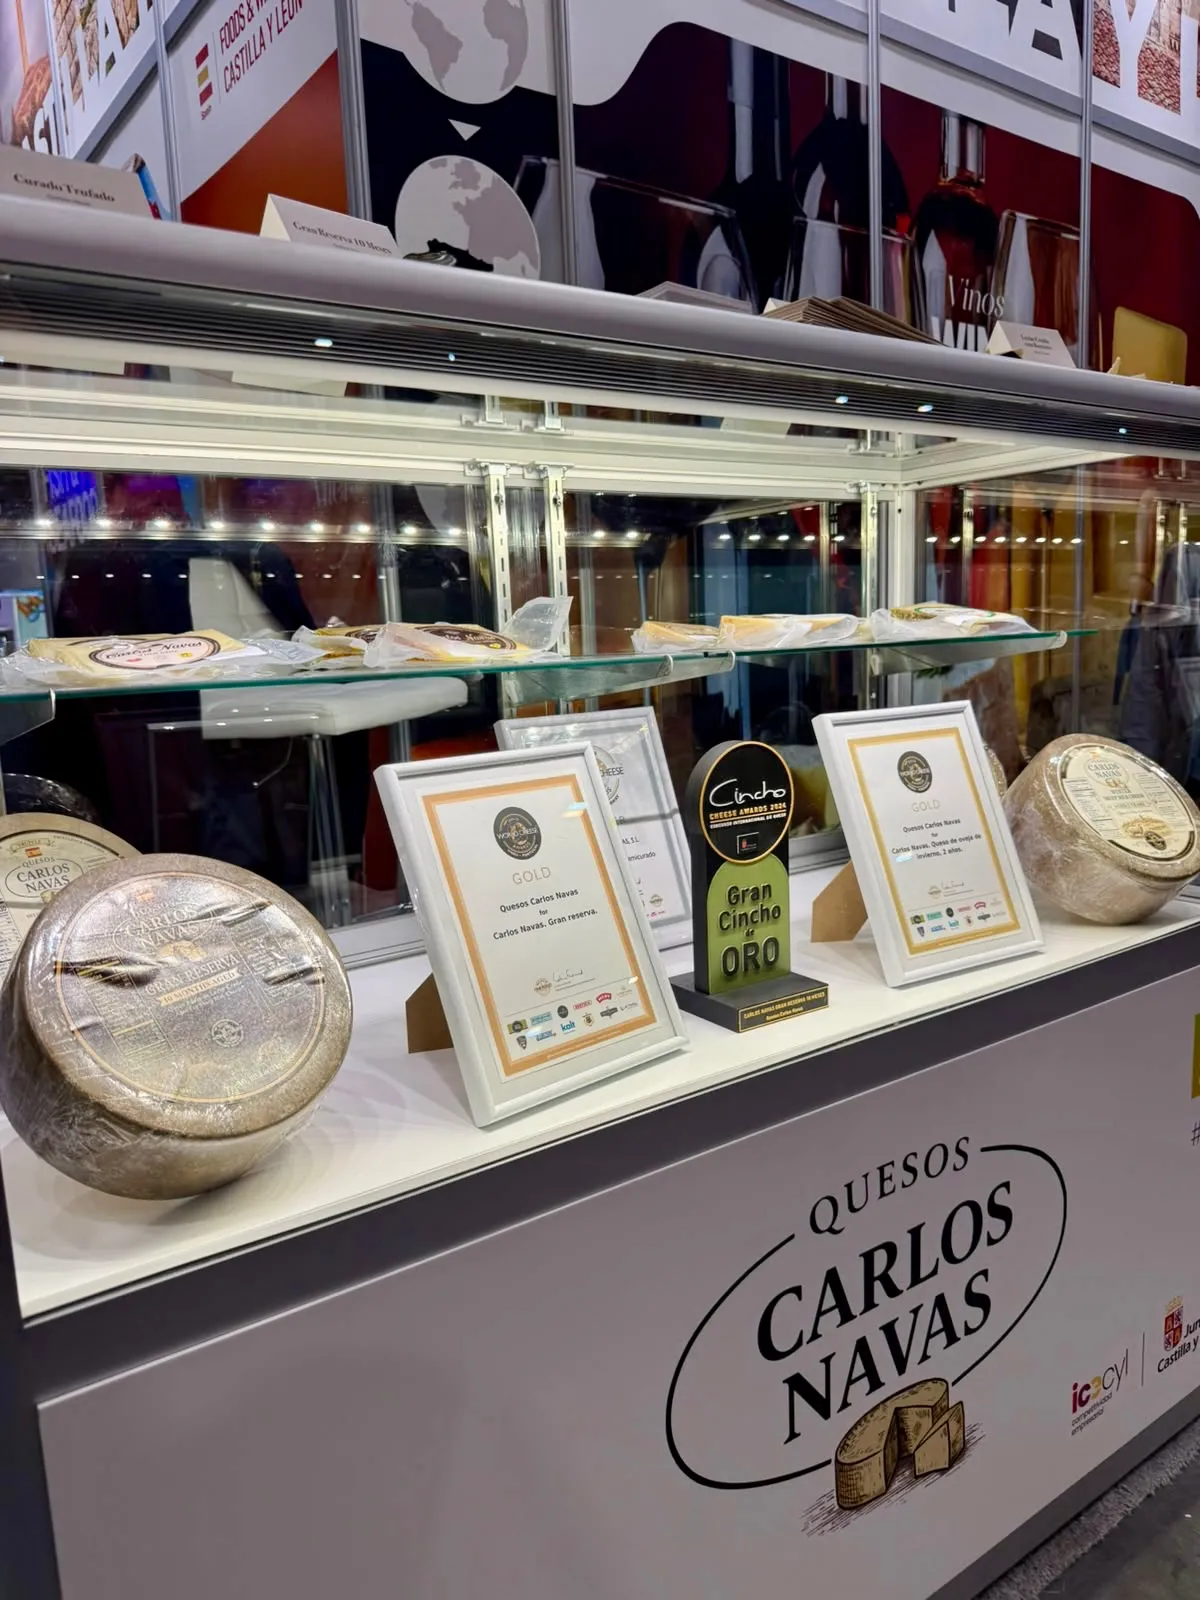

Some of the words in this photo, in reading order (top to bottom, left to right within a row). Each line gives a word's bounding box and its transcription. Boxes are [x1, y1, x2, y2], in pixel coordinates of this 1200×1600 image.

[219, 3, 246, 55] FOODS
[223, 25, 266, 93] CASTILLA
[266, 12, 273, 43] Y
[14, 173, 63, 192] Curado
[63, 183, 115, 202] Trufado
[293, 221, 317, 235] Gran
[948, 274, 1005, 317] Vinos
[709, 779, 786, 807] Cincho
[911, 799, 940, 812] GOLD
[709, 809, 738, 820] CHEESE
[739, 805, 768, 816] AWARDS
[903, 824, 924, 833] Quesos
[925, 820, 943, 830] Carlos
[944, 818, 961, 826] Navas
[892, 846, 911, 855] Carlos
[931, 840, 949, 849] Queso
[958, 834, 974, 844] oveja
[17, 863, 70, 883] CARLOS
[22, 855, 56, 868] QUESOS
[25, 875, 70, 893] NAVAS
[512, 866, 551, 885] GOLD
[499, 901, 529, 913] Quesos
[530, 894, 555, 906] Carlos
[555, 887, 579, 899] Navas
[727, 883, 772, 906] Gran
[126, 906, 198, 936] CARLOS
[493, 927, 519, 940] Carlos
[520, 920, 547, 933] Navas.
[548, 915, 567, 926] Gran
[568, 908, 598, 921] reserva.
[539, 908, 548, 916] for
[719, 903, 781, 931] Cincho
[139, 924, 200, 949] NAVAS
[745, 928, 755, 937] de
[185, 953, 240, 981] RESERVA
[721, 936, 780, 977] ORO
[809, 1136, 970, 1236] QUESOS
[757, 1181, 1013, 1362] CARLOS
[784, 1268, 992, 1445] NAVAS
[1157, 1342, 1191, 1373] Castilla
[1192, 1335, 1199, 1352] y
